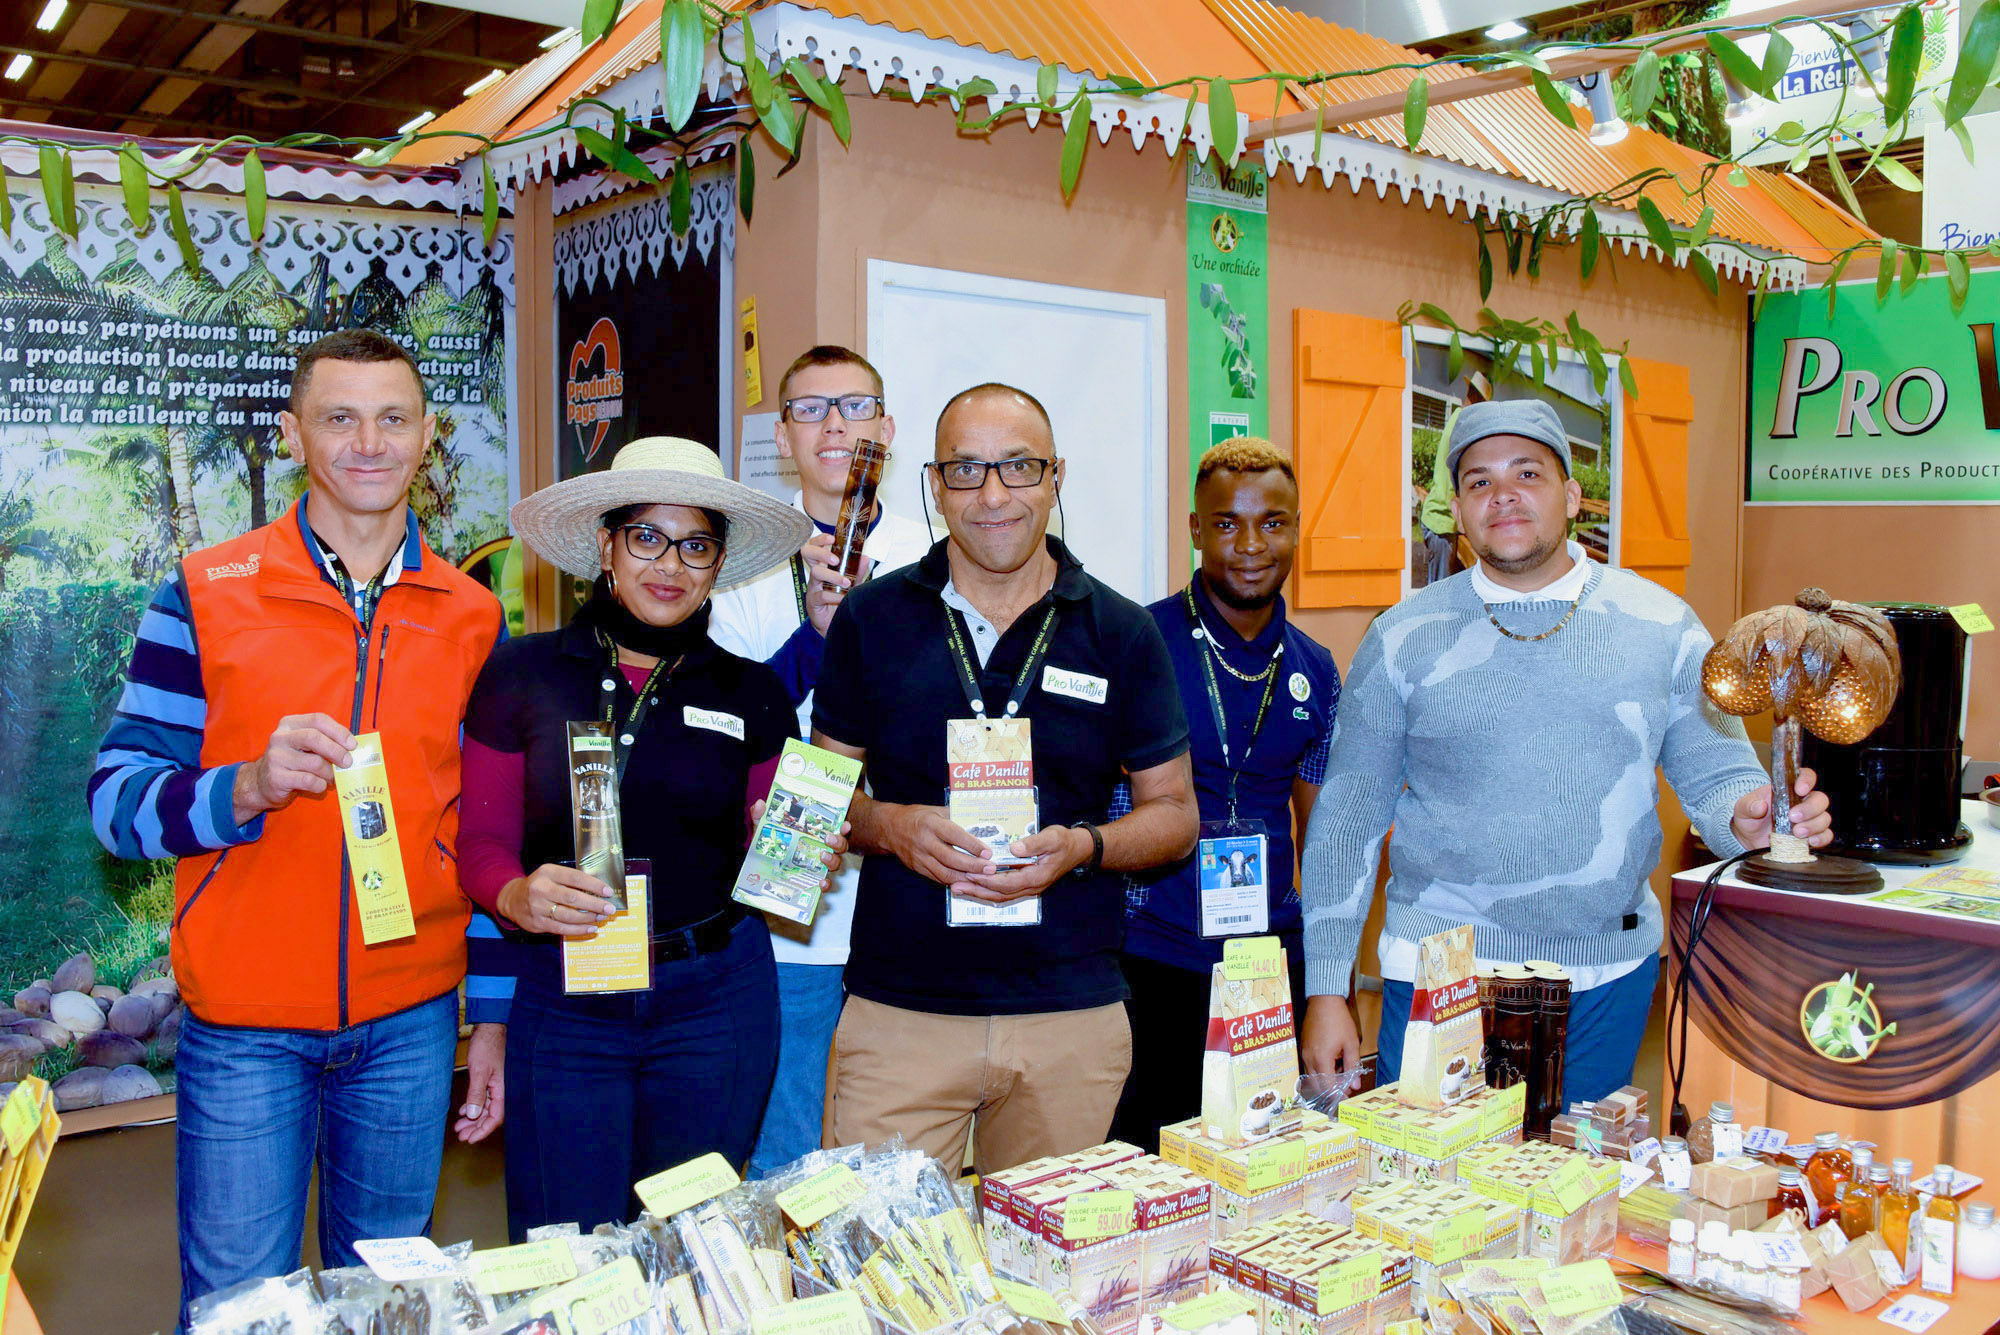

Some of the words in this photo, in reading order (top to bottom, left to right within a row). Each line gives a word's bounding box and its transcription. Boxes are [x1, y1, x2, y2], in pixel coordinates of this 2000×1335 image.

[1782, 72, 1805, 99] La
[1192, 252, 1217, 271] Une
[1220, 258, 1261, 277] orchidée
[27, 317, 89, 335] nous
[100, 318, 238, 342] perpétuons
[247, 330, 277, 343] un
[428, 333, 481, 351] aussi
[26, 344, 160, 368] production
[167, 347, 239, 370] locale
[245, 351, 298, 371] dans
[418, 358, 481, 377] aturel
[10, 372, 95, 394] niveau
[101, 374, 130, 395] de
[136, 375, 161, 396] la
[168, 376, 292, 401] préparatio
[432, 385, 459, 402] de
[462, 385, 482, 402] la
[566, 373, 624, 402] Produits
[59, 403, 84, 424] la
[91, 404, 209, 426] meilleure
[215, 412, 246, 426] au
[566, 402, 598, 427] Pays
[1069, 677, 1104, 698] Vanille
[711, 715, 743, 735] Vanille
[573, 762, 615, 776] VANILLE
[824, 766, 855, 788] Vanille
[953, 763, 981, 780] Café
[985, 761, 1030, 777] Vanille
[342, 786, 385, 801] VANILLE
[953, 780, 965, 788] de
[967, 778, 1029, 788] BRAS-PANON
[1226, 961, 1250, 970] VANILLE
[1271, 959, 1277, 972] €
[1432, 989, 1450, 1010] Café
[1451, 978, 1477, 1001] Vanille
[1435, 1011, 1442, 1021] de
[1442, 996, 1478, 1019] BRAS-PANON
[1229, 1016, 1253, 1040] Café
[1255, 1008, 1291, 1032] Vanille
[1233, 1041, 1243, 1052] de
[1244, 1026, 1293, 1049] BRAS-PANON
[1307, 1162, 1315, 1172] de
[1316, 1149, 1356, 1170] BRAS-PANON
[1308, 1143, 1323, 1163] Sel
[1325, 1134, 1356, 1156] Vanille
[804, 1166, 844, 1191] STANDARD
[1100, 1204, 1122, 1213] VANILLE
[1147, 1200, 1178, 1219] Poudre
[1180, 1186, 1209, 1208] Vanille
[1097, 1212, 1123, 1232] 59.00
[1124, 1211, 1131, 1229] €
[1147, 1219, 1157, 1229] de
[1158, 1204, 1209, 1226] BRAS-PANON
[1074, 1239, 1083, 1248] de
[592, 1293, 630, 1327] 8.10
[632, 1286, 646, 1307] €
